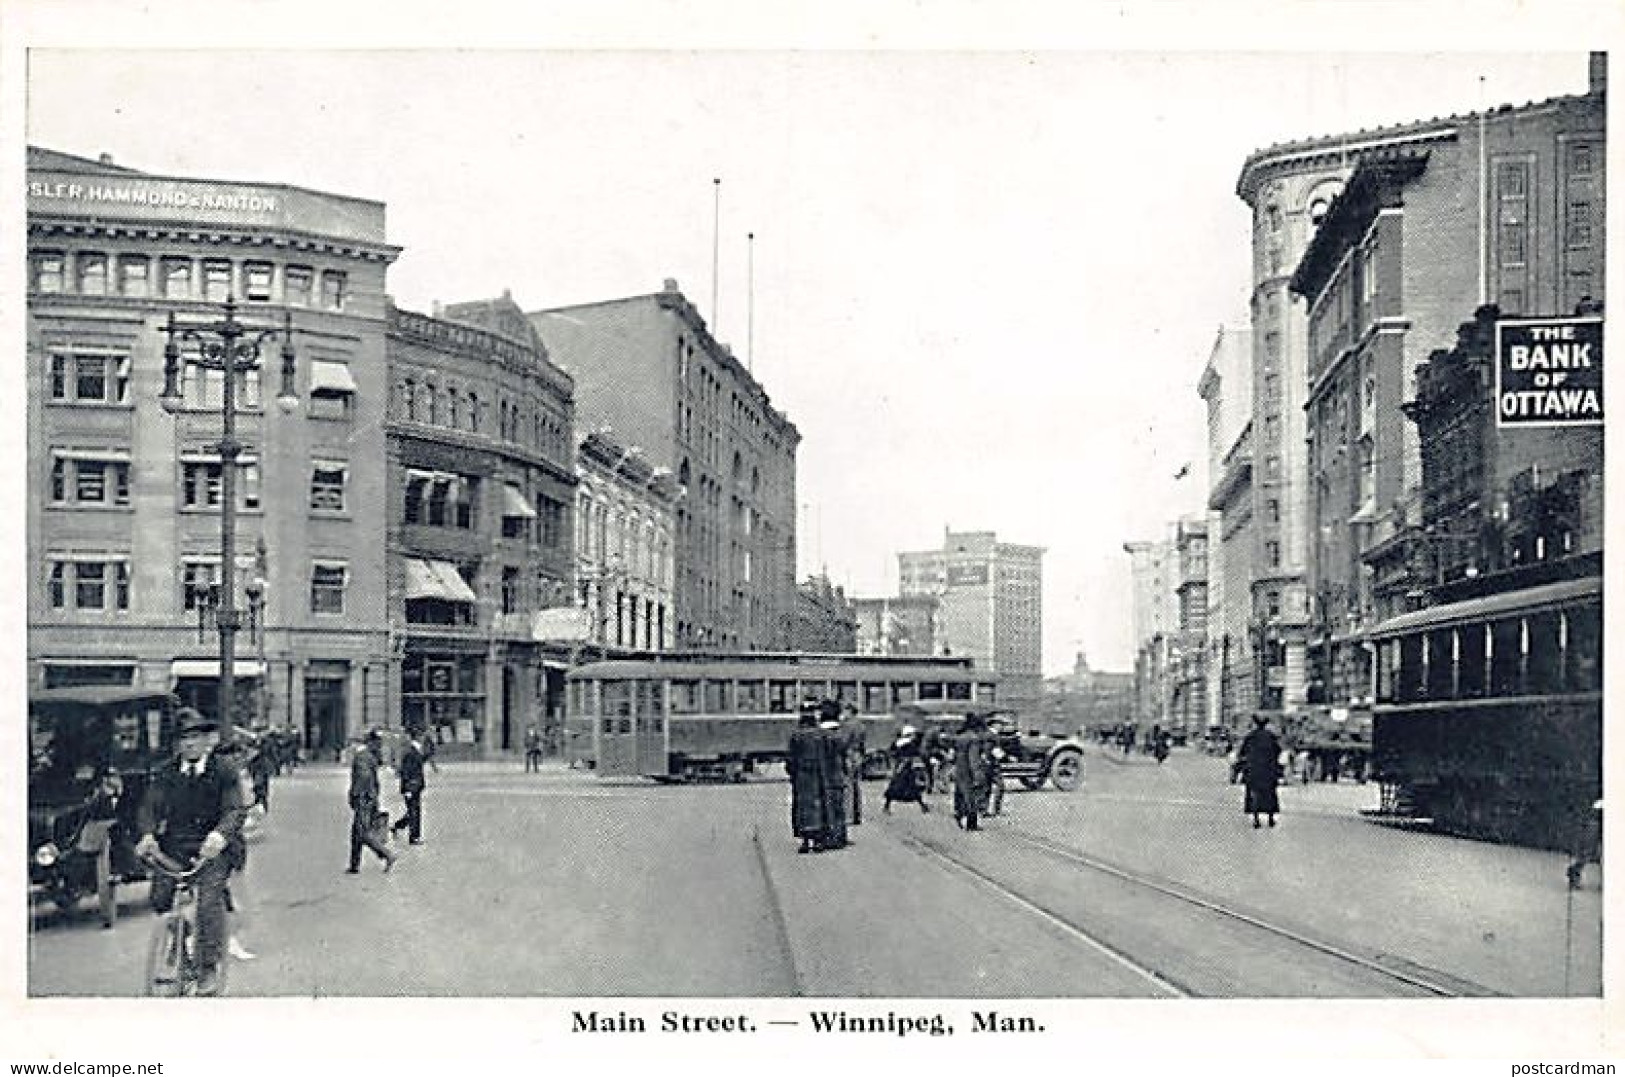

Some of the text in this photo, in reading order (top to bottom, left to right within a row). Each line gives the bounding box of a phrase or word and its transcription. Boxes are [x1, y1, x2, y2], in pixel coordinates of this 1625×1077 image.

[27, 182, 87, 201] SLER,
[89, 186, 187, 206] HAMMOND
[1530, 326, 1576, 340] THE
[1511, 343, 1592, 370] BANK
[1534, 372, 1568, 387] OF
[1502, 390, 1601, 416] OTTAWA
